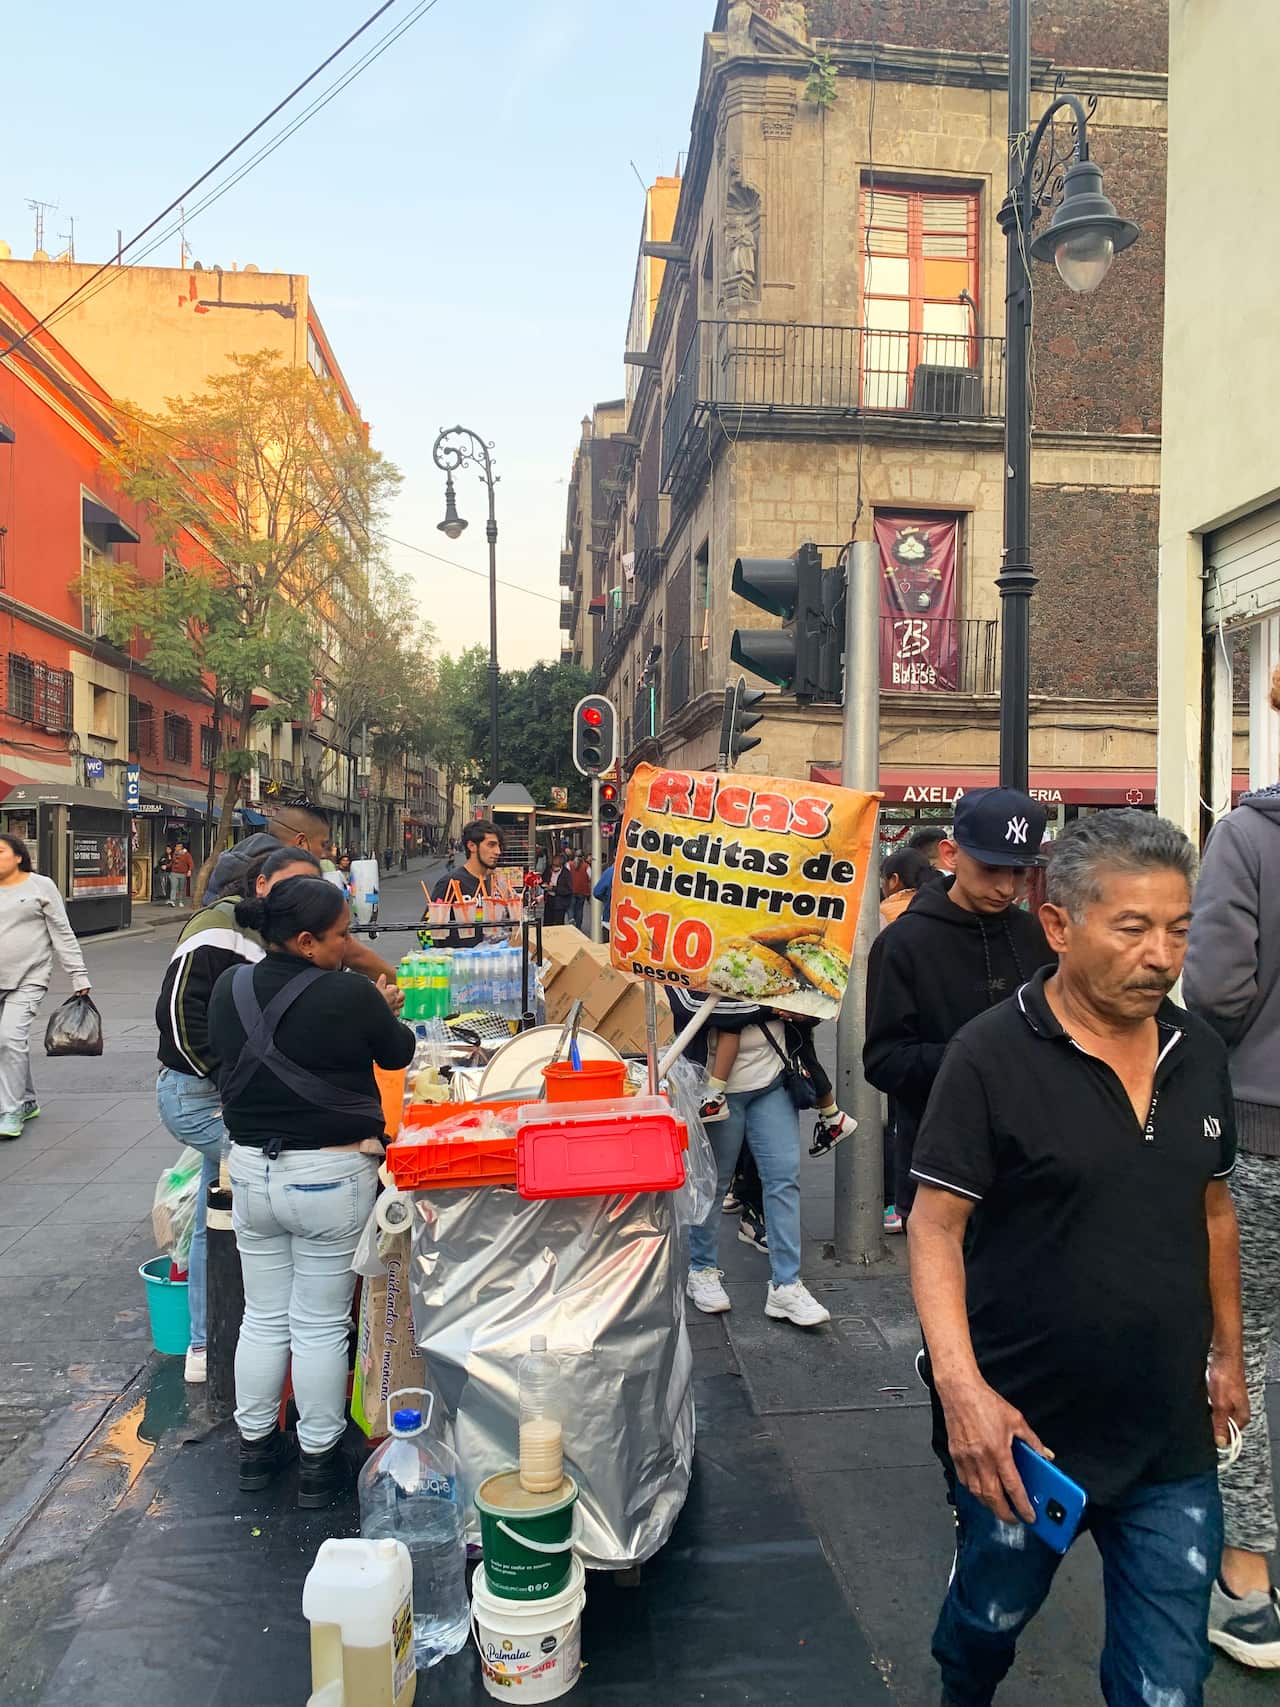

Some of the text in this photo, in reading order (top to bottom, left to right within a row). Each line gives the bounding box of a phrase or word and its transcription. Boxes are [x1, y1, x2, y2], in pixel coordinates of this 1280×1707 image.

[87, 762, 102, 771] WC
[128, 772, 139, 794] WC
[903, 786, 1062, 803] AXELA ERIA
[647, 770, 833, 839] Ricas
[1005, 815, 1029, 844] NY
[625, 818, 855, 884] Gorditas de
[620, 855, 846, 921] Chicharron
[614, 898, 714, 972] $10
[632, 960, 691, 987] pesos
[385, 1258, 402, 1329] Cuidando
[384, 1330, 398, 1346] el
[487, 1642, 532, 1663] Palmalac
[516, 1657, 557, 1673] YOURT
